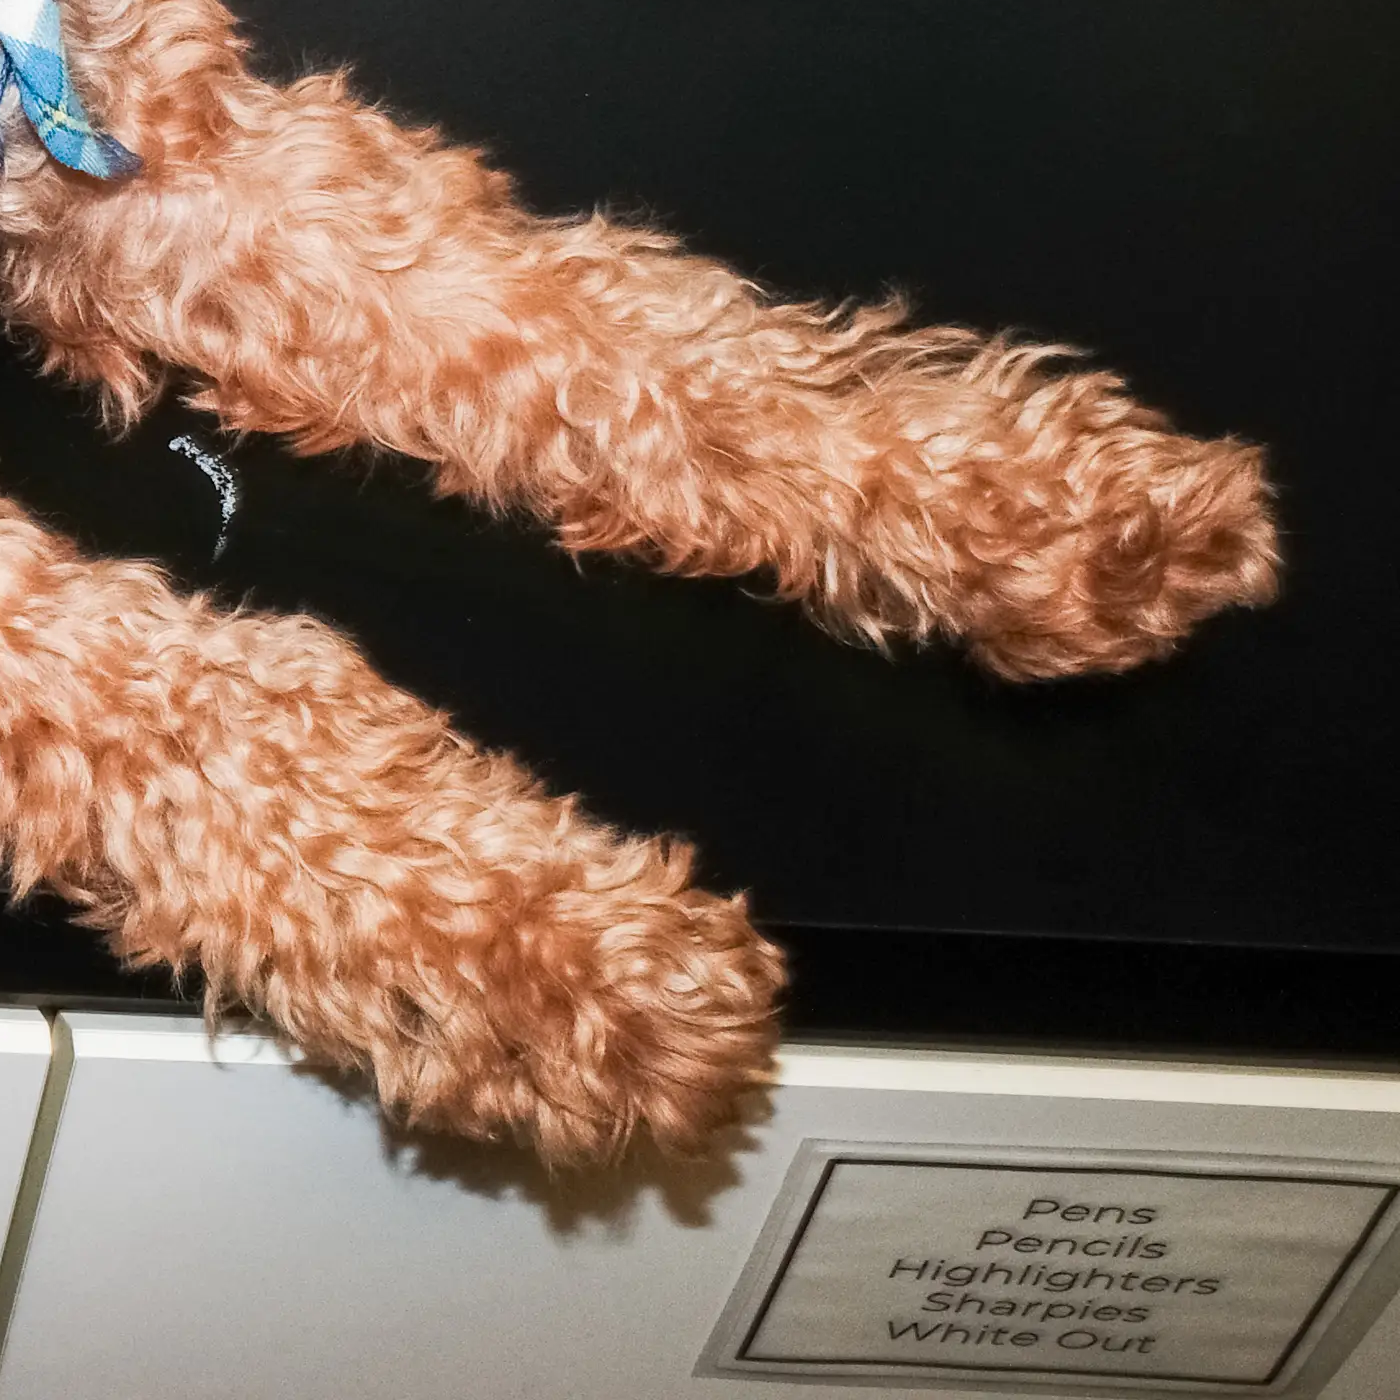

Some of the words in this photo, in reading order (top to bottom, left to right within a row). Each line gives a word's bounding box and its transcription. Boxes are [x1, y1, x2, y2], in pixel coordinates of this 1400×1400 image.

[1021, 1197, 1159, 1226] Pens
[974, 1228, 1168, 1260] Pencils
[887, 1257, 1222, 1296] Highlighters
[919, 1290, 1152, 1324] Sharpies
[885, 1319, 1040, 1350] White
[1056, 1327, 1158, 1356] Out
